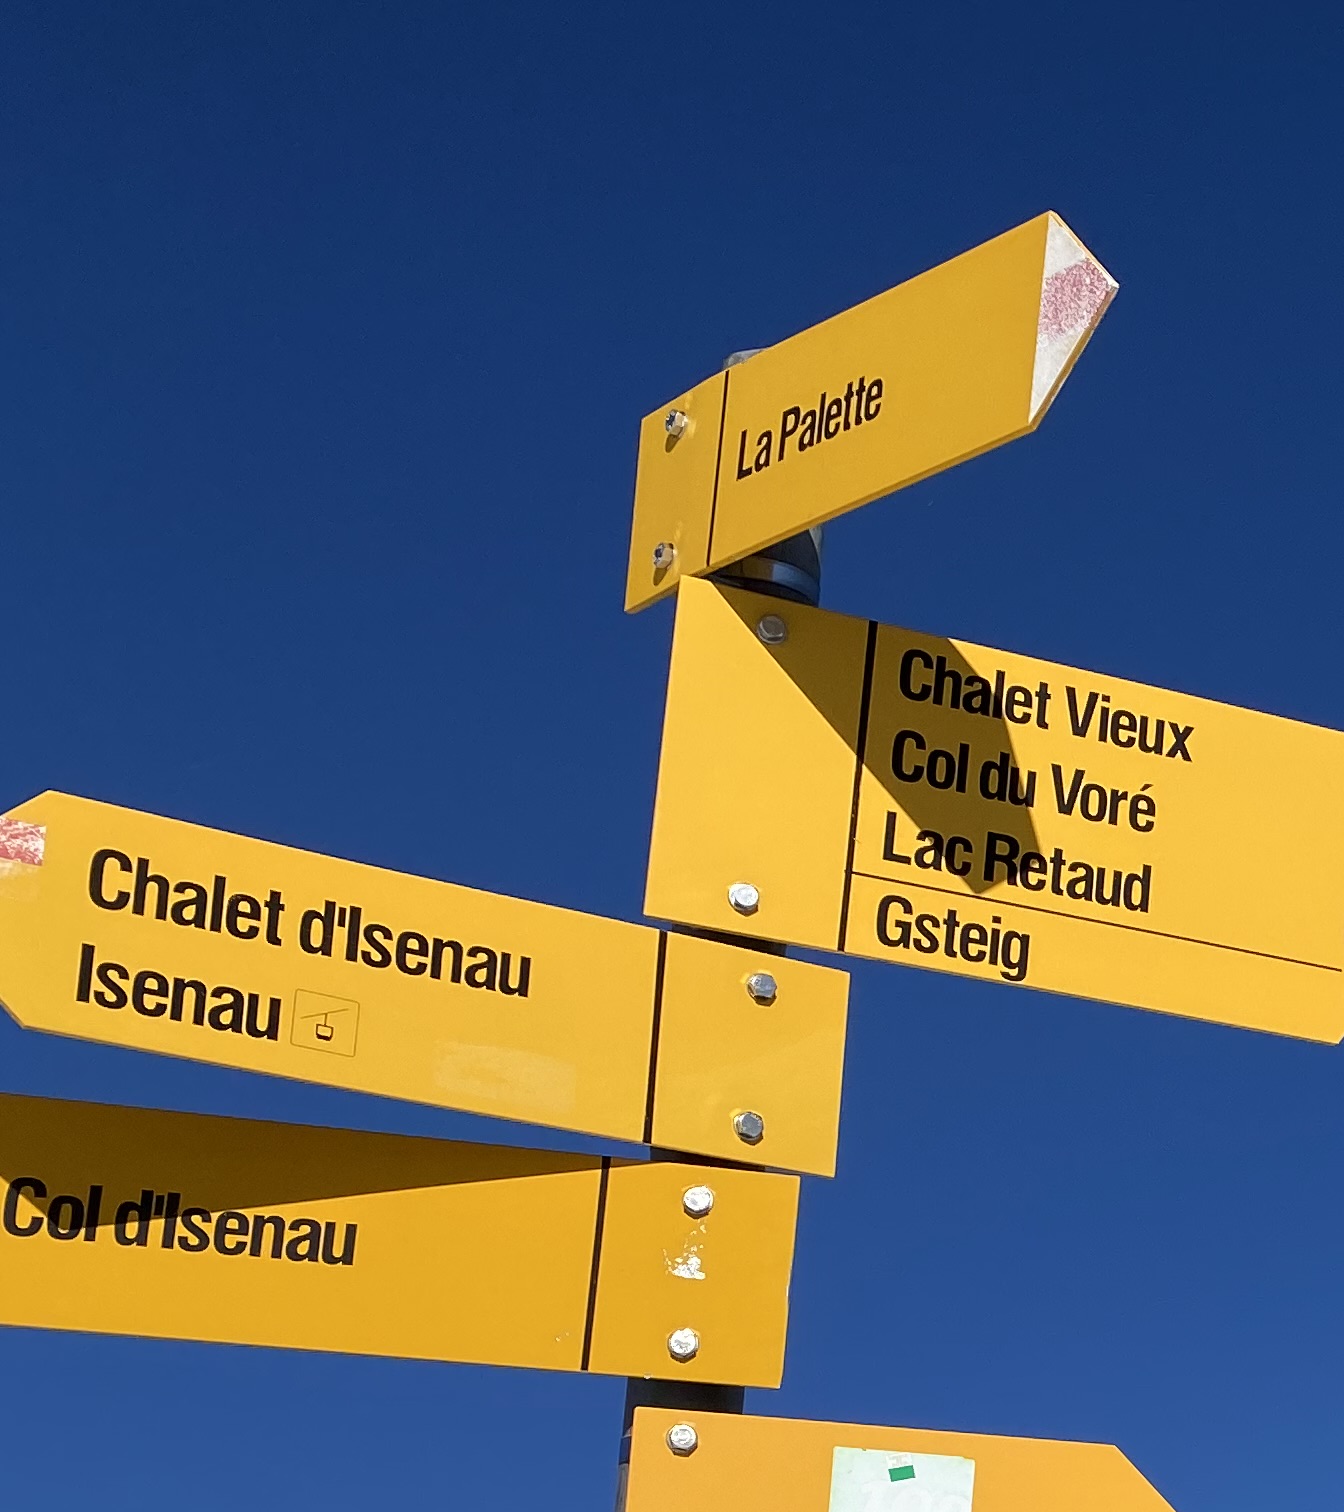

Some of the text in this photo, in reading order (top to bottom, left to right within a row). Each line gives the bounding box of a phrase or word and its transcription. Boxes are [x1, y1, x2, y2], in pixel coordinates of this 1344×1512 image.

[736, 376, 883, 482] La Palette
[899, 648, 1195, 762] Chalet Vieux
[891, 730, 1156, 833] Col du Voré
[882, 811, 1152, 913] Lac Retaud
[88, 848, 532, 998] Chalet d'Isenau
[876, 894, 1030, 982] Gsteig
[75, 943, 282, 1041] Isenau
[2, 1176, 358, 1266] Col d'Isenau
